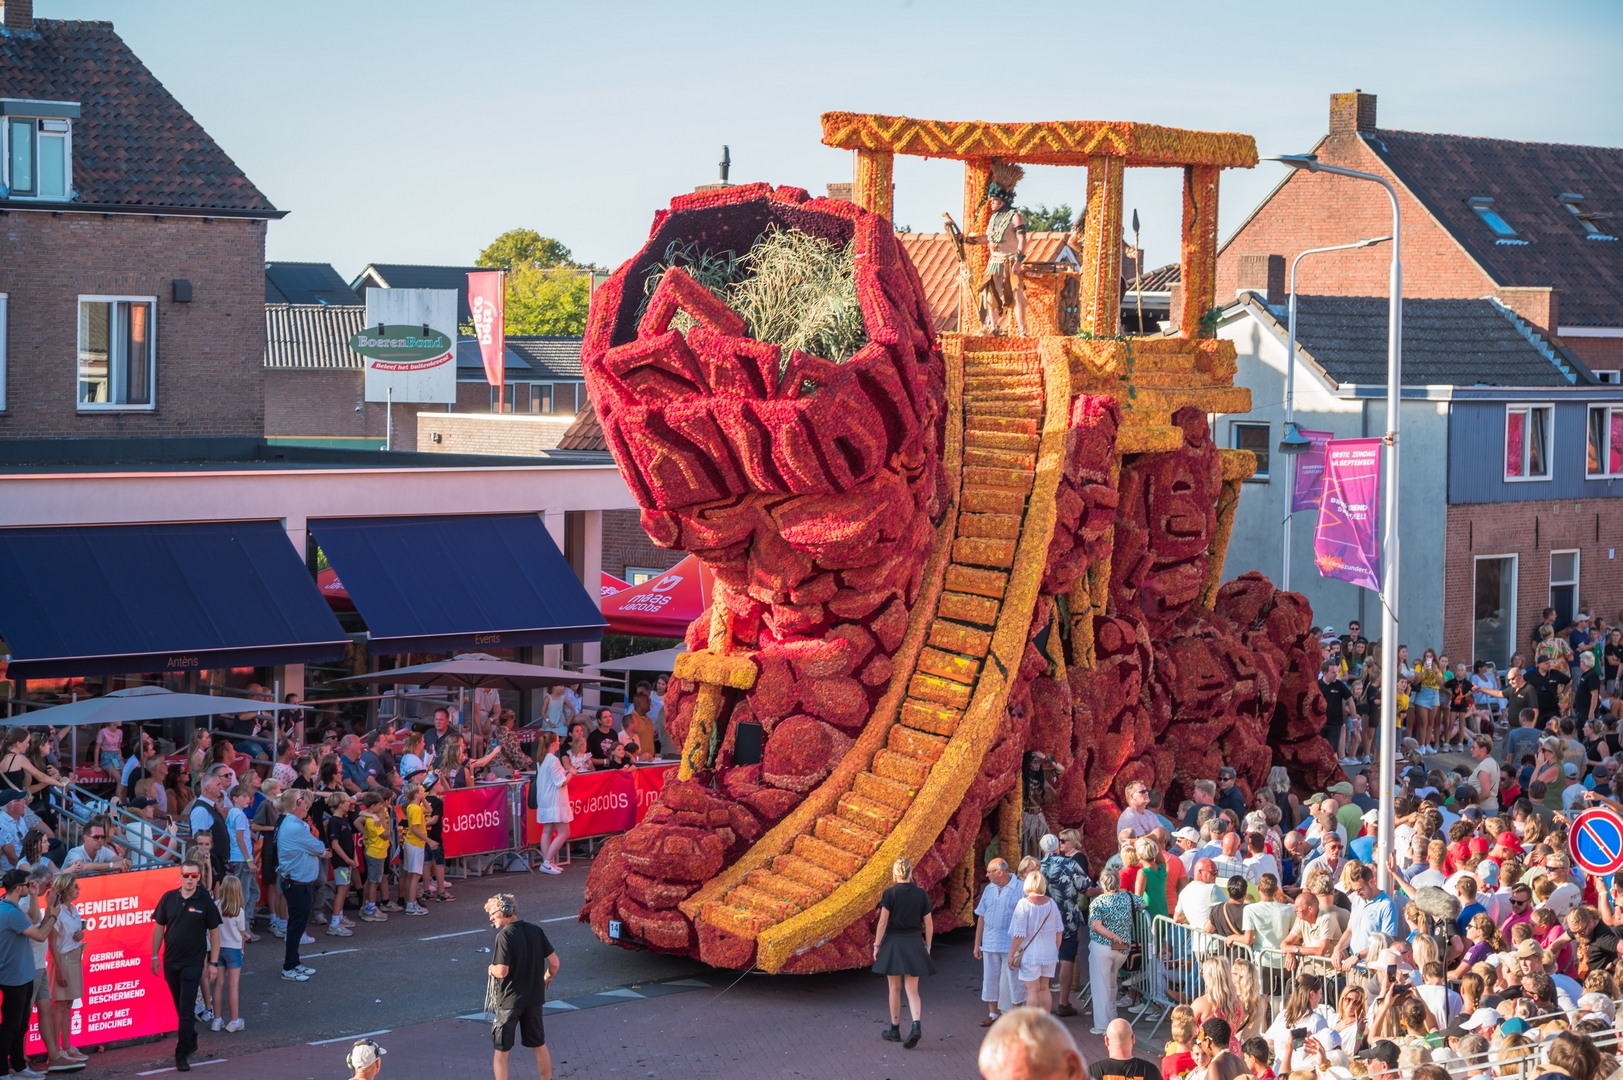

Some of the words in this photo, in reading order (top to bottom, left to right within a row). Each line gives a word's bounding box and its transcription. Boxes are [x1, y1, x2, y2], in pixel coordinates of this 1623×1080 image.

[357, 335, 443, 348] BoerenBond
[375, 363, 397, 371] Beleef
[1352, 450, 1376, 458] ZONDAG
[1339, 459, 1375, 467] SEPTEMBER
[628, 593, 672, 605] maas
[475, 634, 500, 645] Events
[76, 896, 139, 916] GENIETEN
[610, 923, 619, 932] 14
[90, 950, 124, 962] GEBRUIK
[89, 957, 141, 972] ZONNEBRAND
[89, 984, 113, 995] KLEED
[114, 979, 140, 991] JEZELF
[88, 989, 145, 1005] BESCHERMEND
[88, 1013, 101, 1022] LET
[102, 1010, 113, 1019] OP
[114, 1008, 130, 1018] MET
[88, 1017, 133, 1032] MEDICIJNEN
